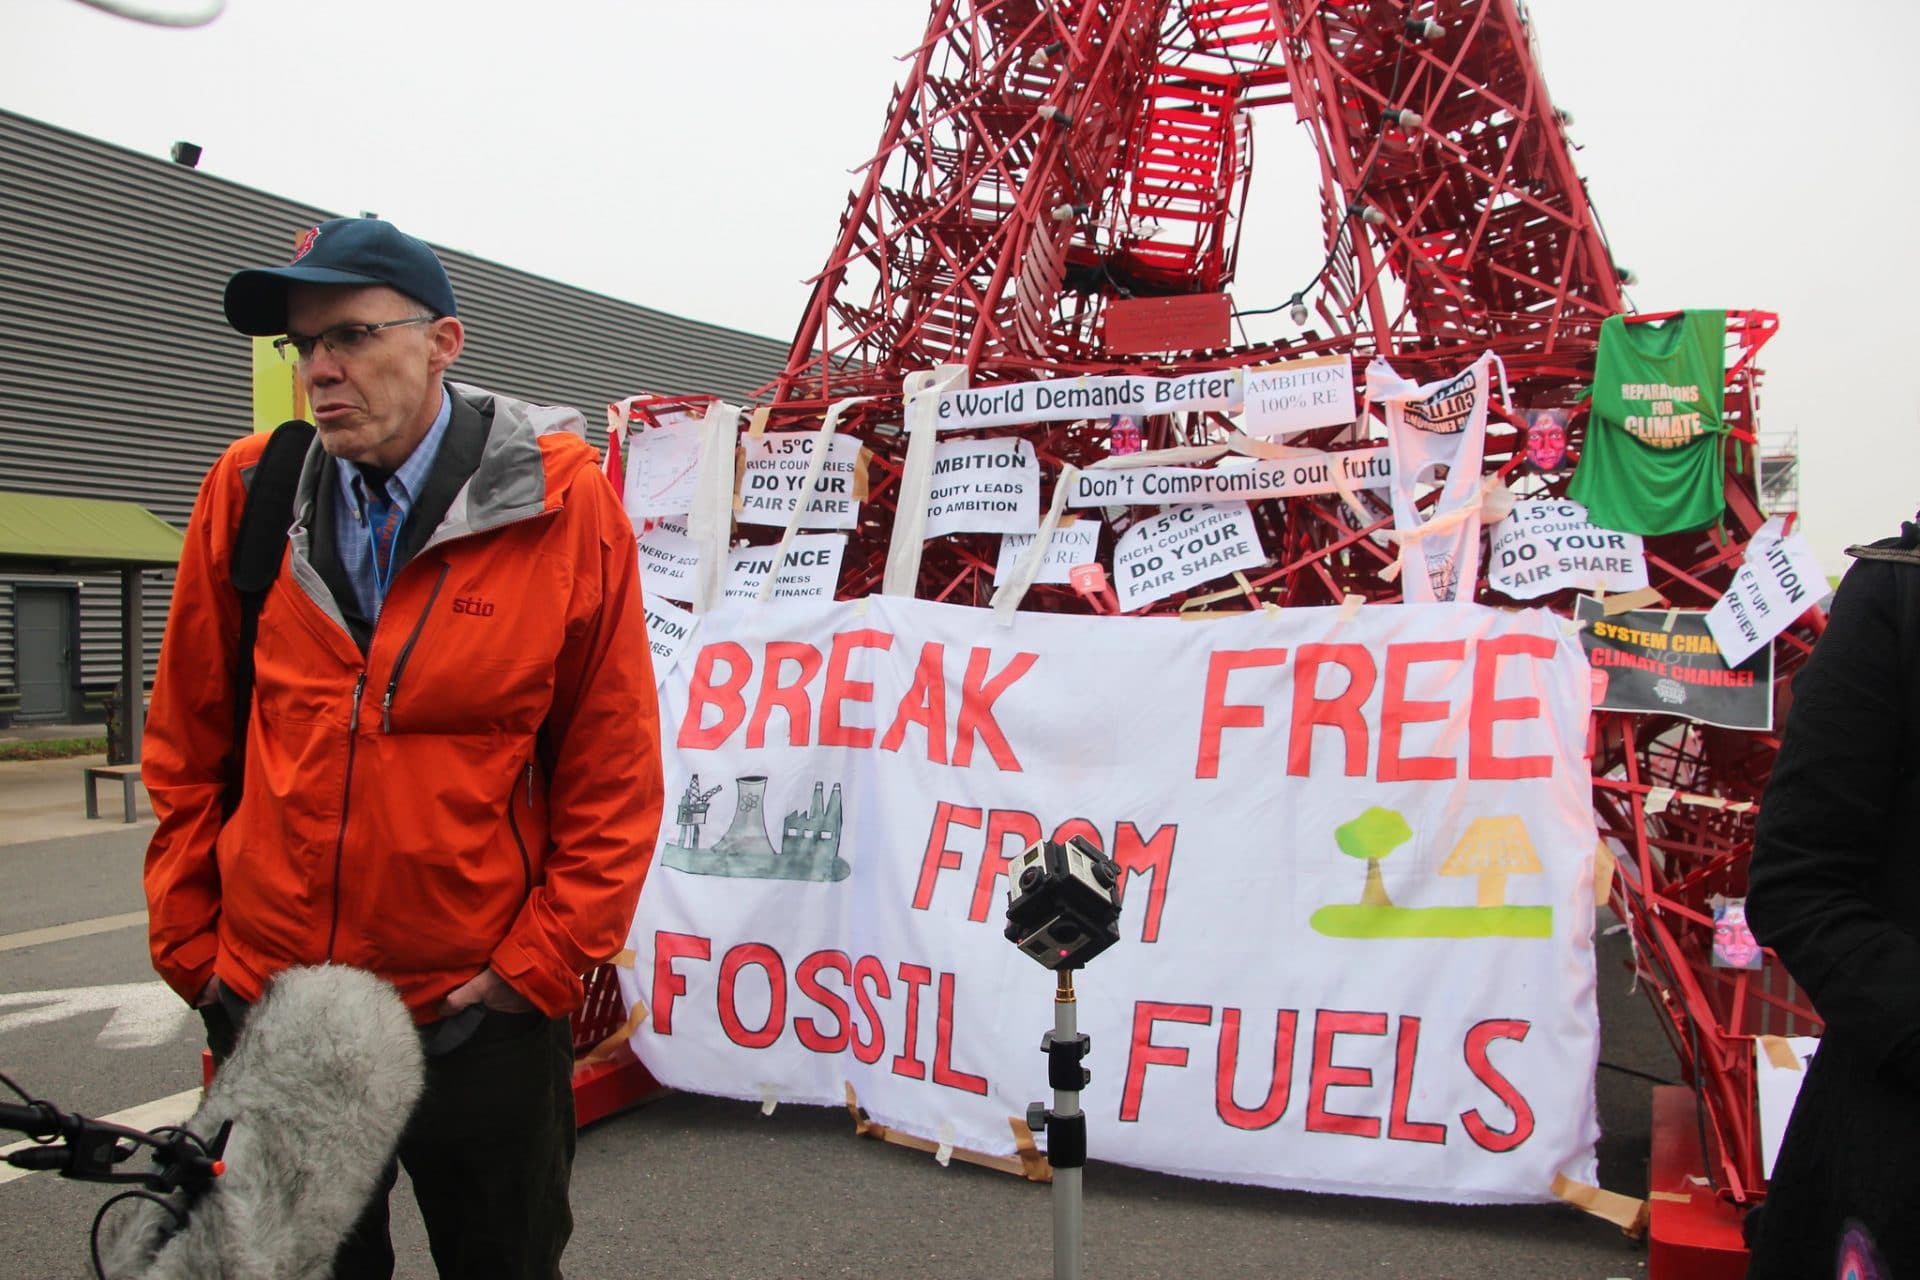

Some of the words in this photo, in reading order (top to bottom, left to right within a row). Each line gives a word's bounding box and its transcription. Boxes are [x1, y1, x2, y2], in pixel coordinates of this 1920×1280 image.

[1247, 367, 1345, 394] AMBITION
[956, 388, 1023, 418] World
[1036, 377, 1145, 410] Demands
[1155, 376, 1235, 403] Better
[1261, 395, 1307, 414] 100%
[1312, 389, 1338, 406] RE
[1446, 391, 1475, 415] CUT
[1652, 401, 1674, 415] FOR
[1429, 402, 1443, 419] IT
[1624, 412, 1705, 437] CLIMATE
[746, 459, 776, 470] RICH
[780, 460, 855, 473] COUNRIES
[932, 453, 1026, 476] MBITION
[751, 474, 779, 490] DO
[786, 476, 846, 493] YUR
[1079, 474, 1135, 498] Don't
[1142, 467, 1286, 496] Compromise
[1342, 456, 1391, 480] futu
[930, 484, 970, 500] QUITY
[975, 483, 1023, 494] LEADS
[742, 495, 783, 511] FAIR
[788, 498, 849, 513] SARE
[946, 501, 1018, 514] AMBITION
[734, 550, 831, 574] FINNCE
[1119, 543, 1154, 565] RICH
[1130, 556, 1164, 578] DO
[1171, 522, 1240, 561] YOUR
[1502, 543, 1537, 568] DO
[1546, 534, 1626, 552] YOUR
[647, 562, 669, 575] FOR
[669, 569, 685, 578] ALL
[1128, 571, 1176, 598] FAIR
[1181, 541, 1250, 577] SHARE
[1500, 564, 1552, 588] FAIR
[1558, 556, 1633, 574] SHARE
[1766, 550, 1806, 604] ITION
[743, 580, 760, 588] NO
[775, 587, 824, 598] FINANCE
[1726, 591, 1760, 643] REVIEW
[1593, 621, 1668, 650] SYSTEM
[650, 640, 674, 658] RES
[1645, 648, 1698, 667] NOT
[1590, 647, 1667, 677] CLIMATE
[1671, 664, 1755, 688] CHANGE!
[677, 628, 1041, 773] BREAK
[1195, 633, 1558, 783] FREE
[651, 929, 989, 1097] FOSSIL
[1118, 1000, 1536, 1154] FUELS
